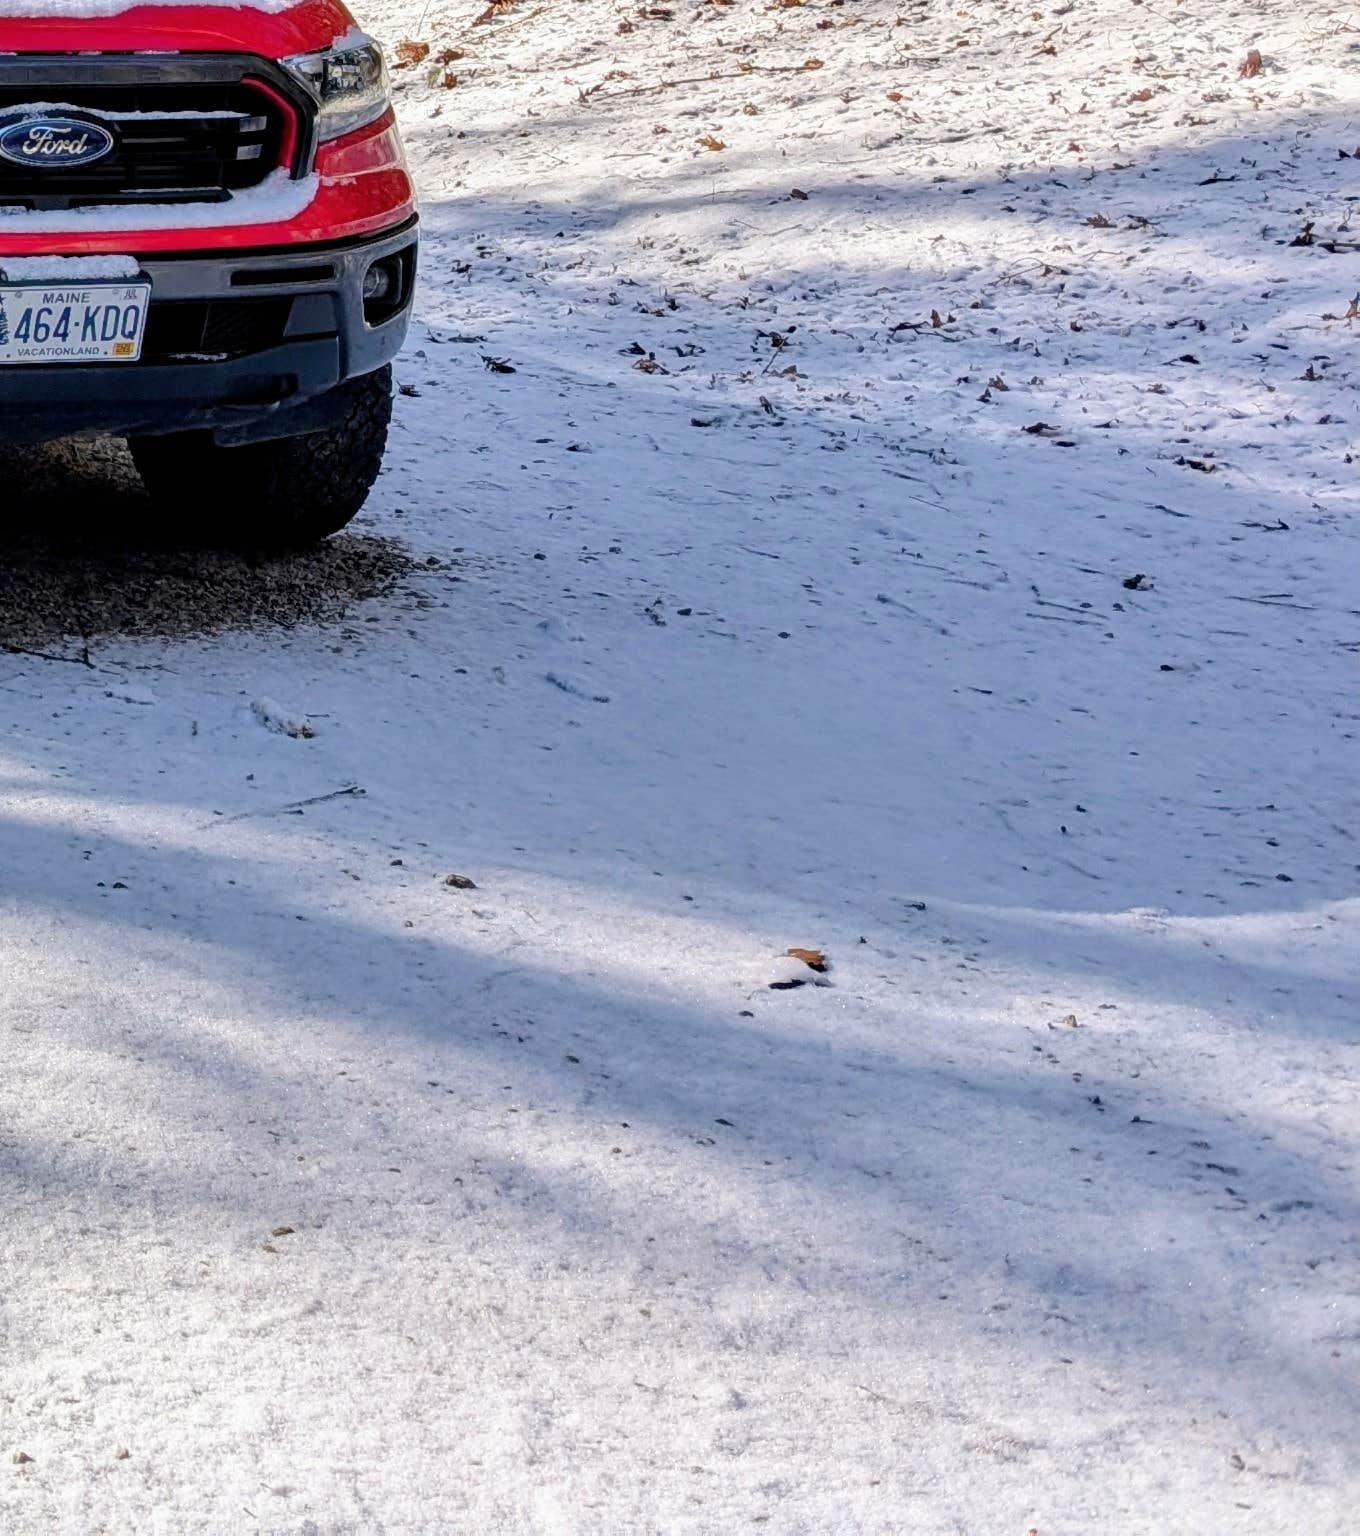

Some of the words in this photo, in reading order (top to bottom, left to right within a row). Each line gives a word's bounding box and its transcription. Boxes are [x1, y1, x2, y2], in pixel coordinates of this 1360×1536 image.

[22, 126, 89, 156] Ford
[42, 292, 91, 305] MAINE
[17, 346, 100, 357] VACATIONLAND
